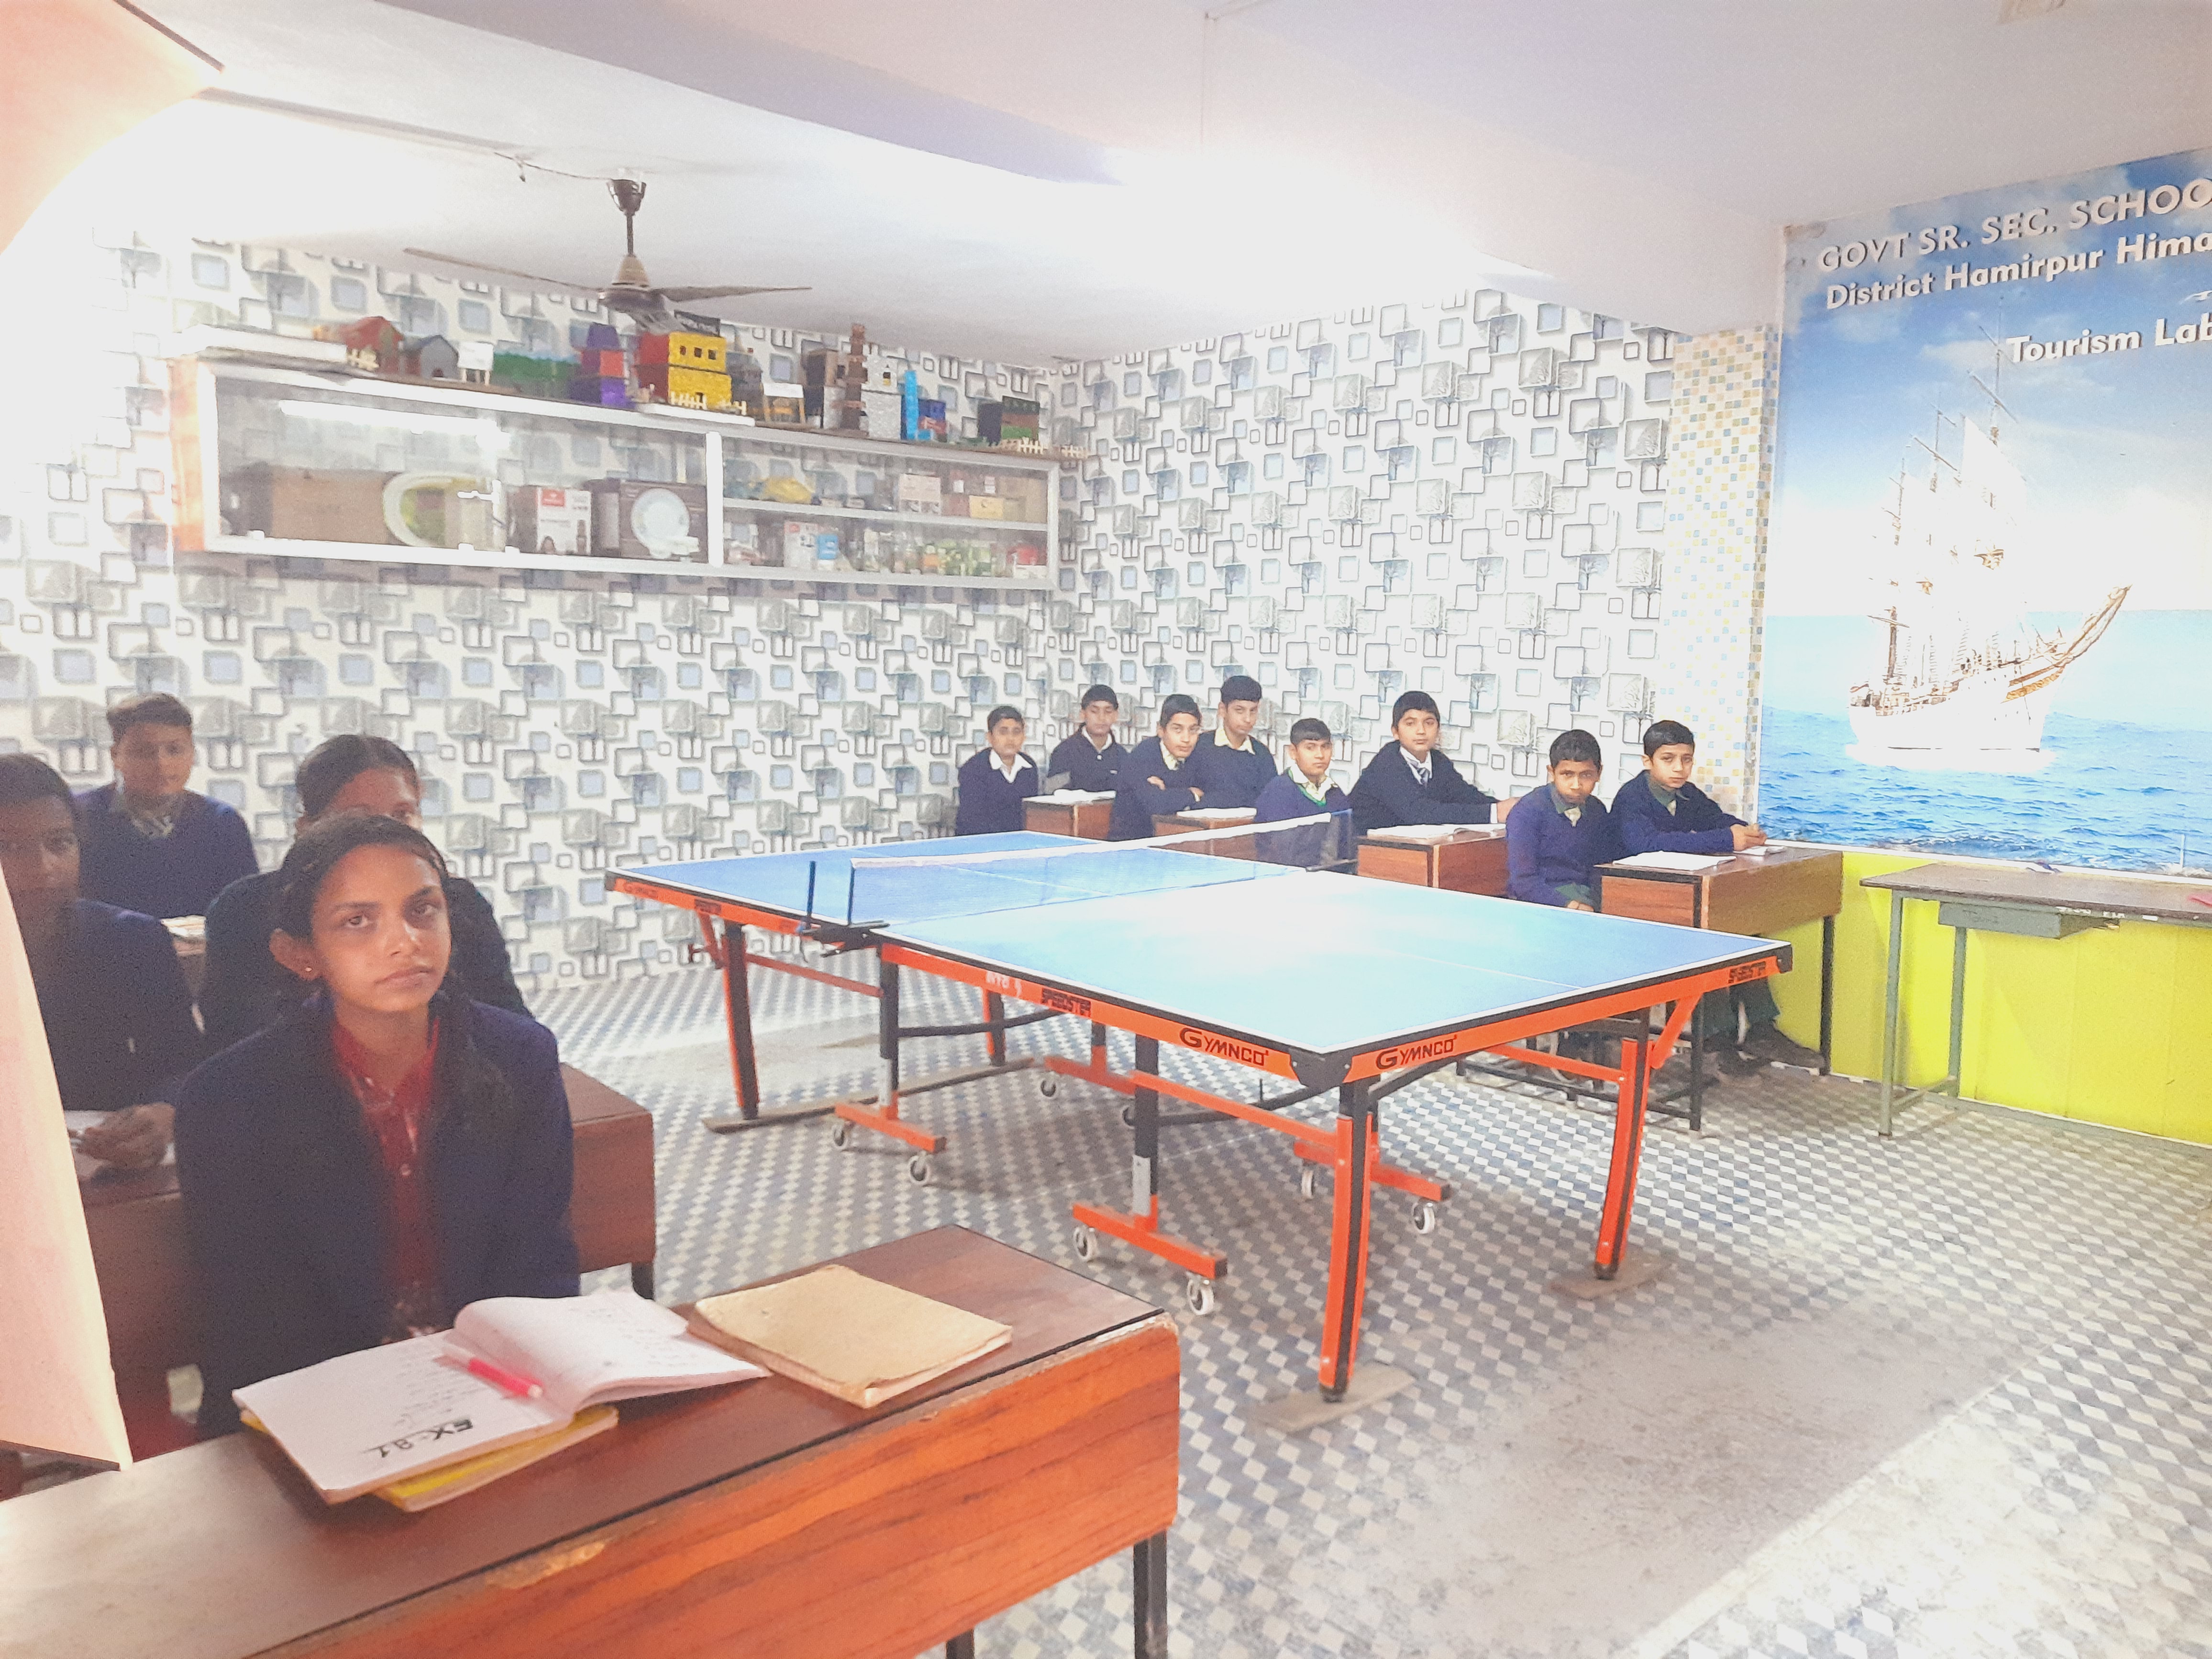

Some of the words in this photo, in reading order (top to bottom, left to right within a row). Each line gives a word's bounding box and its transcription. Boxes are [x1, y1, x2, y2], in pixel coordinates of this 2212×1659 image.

[1817, 232, 1912, 272] GOVT
[1918, 225, 1970, 255] SR.
[1981, 208, 2057, 244] SEC.
[2069, 178, 2212, 229] SCHOO
[1826, 272, 1936, 310] District
[1945, 249, 2105, 291] Hamirpur
[2116, 232, 2212, 264] Hima
[2006, 329, 2143, 363] Tourism
[1179, 1027, 1268, 1066] GYMNCO
[1376, 1036, 1456, 1070] GYMNCO
